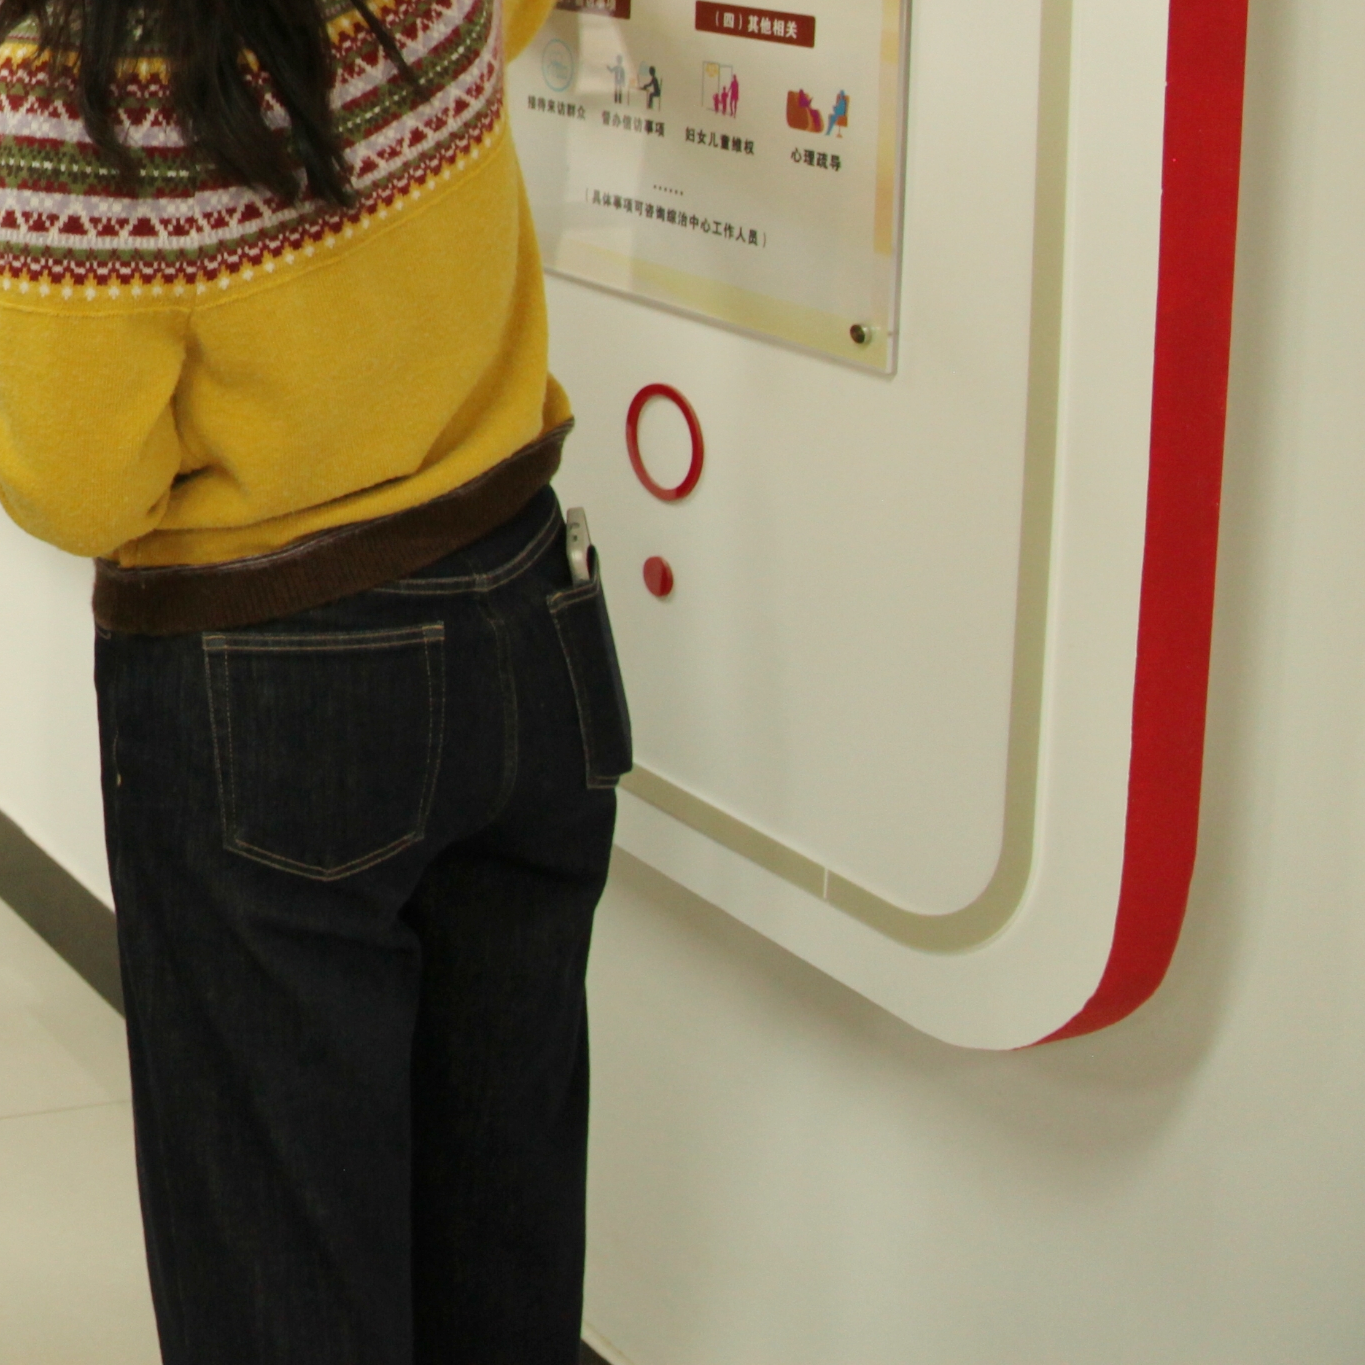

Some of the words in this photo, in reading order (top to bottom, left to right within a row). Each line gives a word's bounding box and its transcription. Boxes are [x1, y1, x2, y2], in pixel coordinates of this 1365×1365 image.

[685, 126, 756, 155] 妇女儿童维权
[790, 147, 842, 172] 心理疏导
